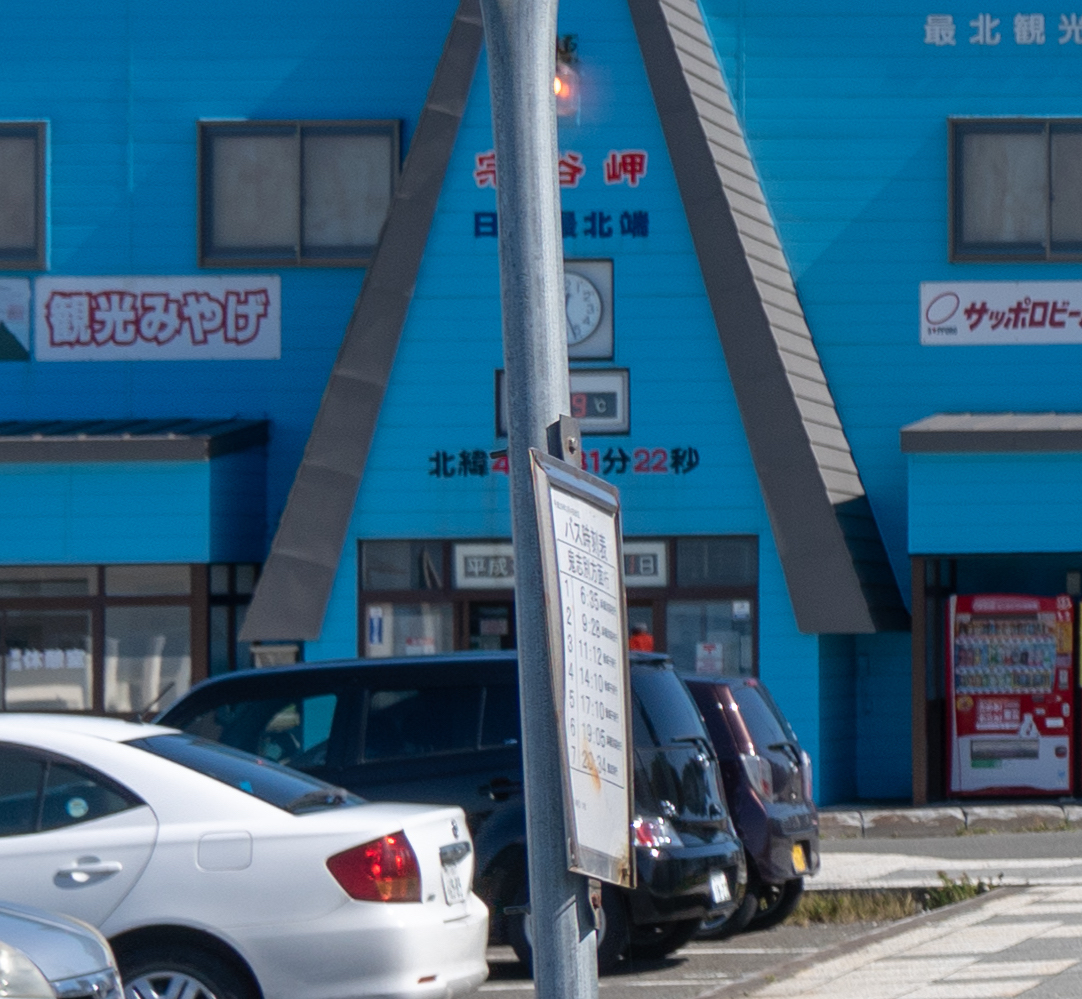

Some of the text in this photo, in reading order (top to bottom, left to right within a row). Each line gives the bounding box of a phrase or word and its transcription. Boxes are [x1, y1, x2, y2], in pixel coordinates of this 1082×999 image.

[44, 288, 270, 348] 観光みやげ
[564, 579, 570, 597] 1
[566, 606, 572, 626] 2
[567, 634, 573, 653] 3
[578, 639, 603, 666] 11:12
[568, 662, 574, 681] 4
[580, 666, 604, 693] 14:10
[568, 689, 575, 709] 5
[581, 694, 605, 721] 17:10
[570, 717, 576, 737] 6
[570, 745, 576, 765] 7
